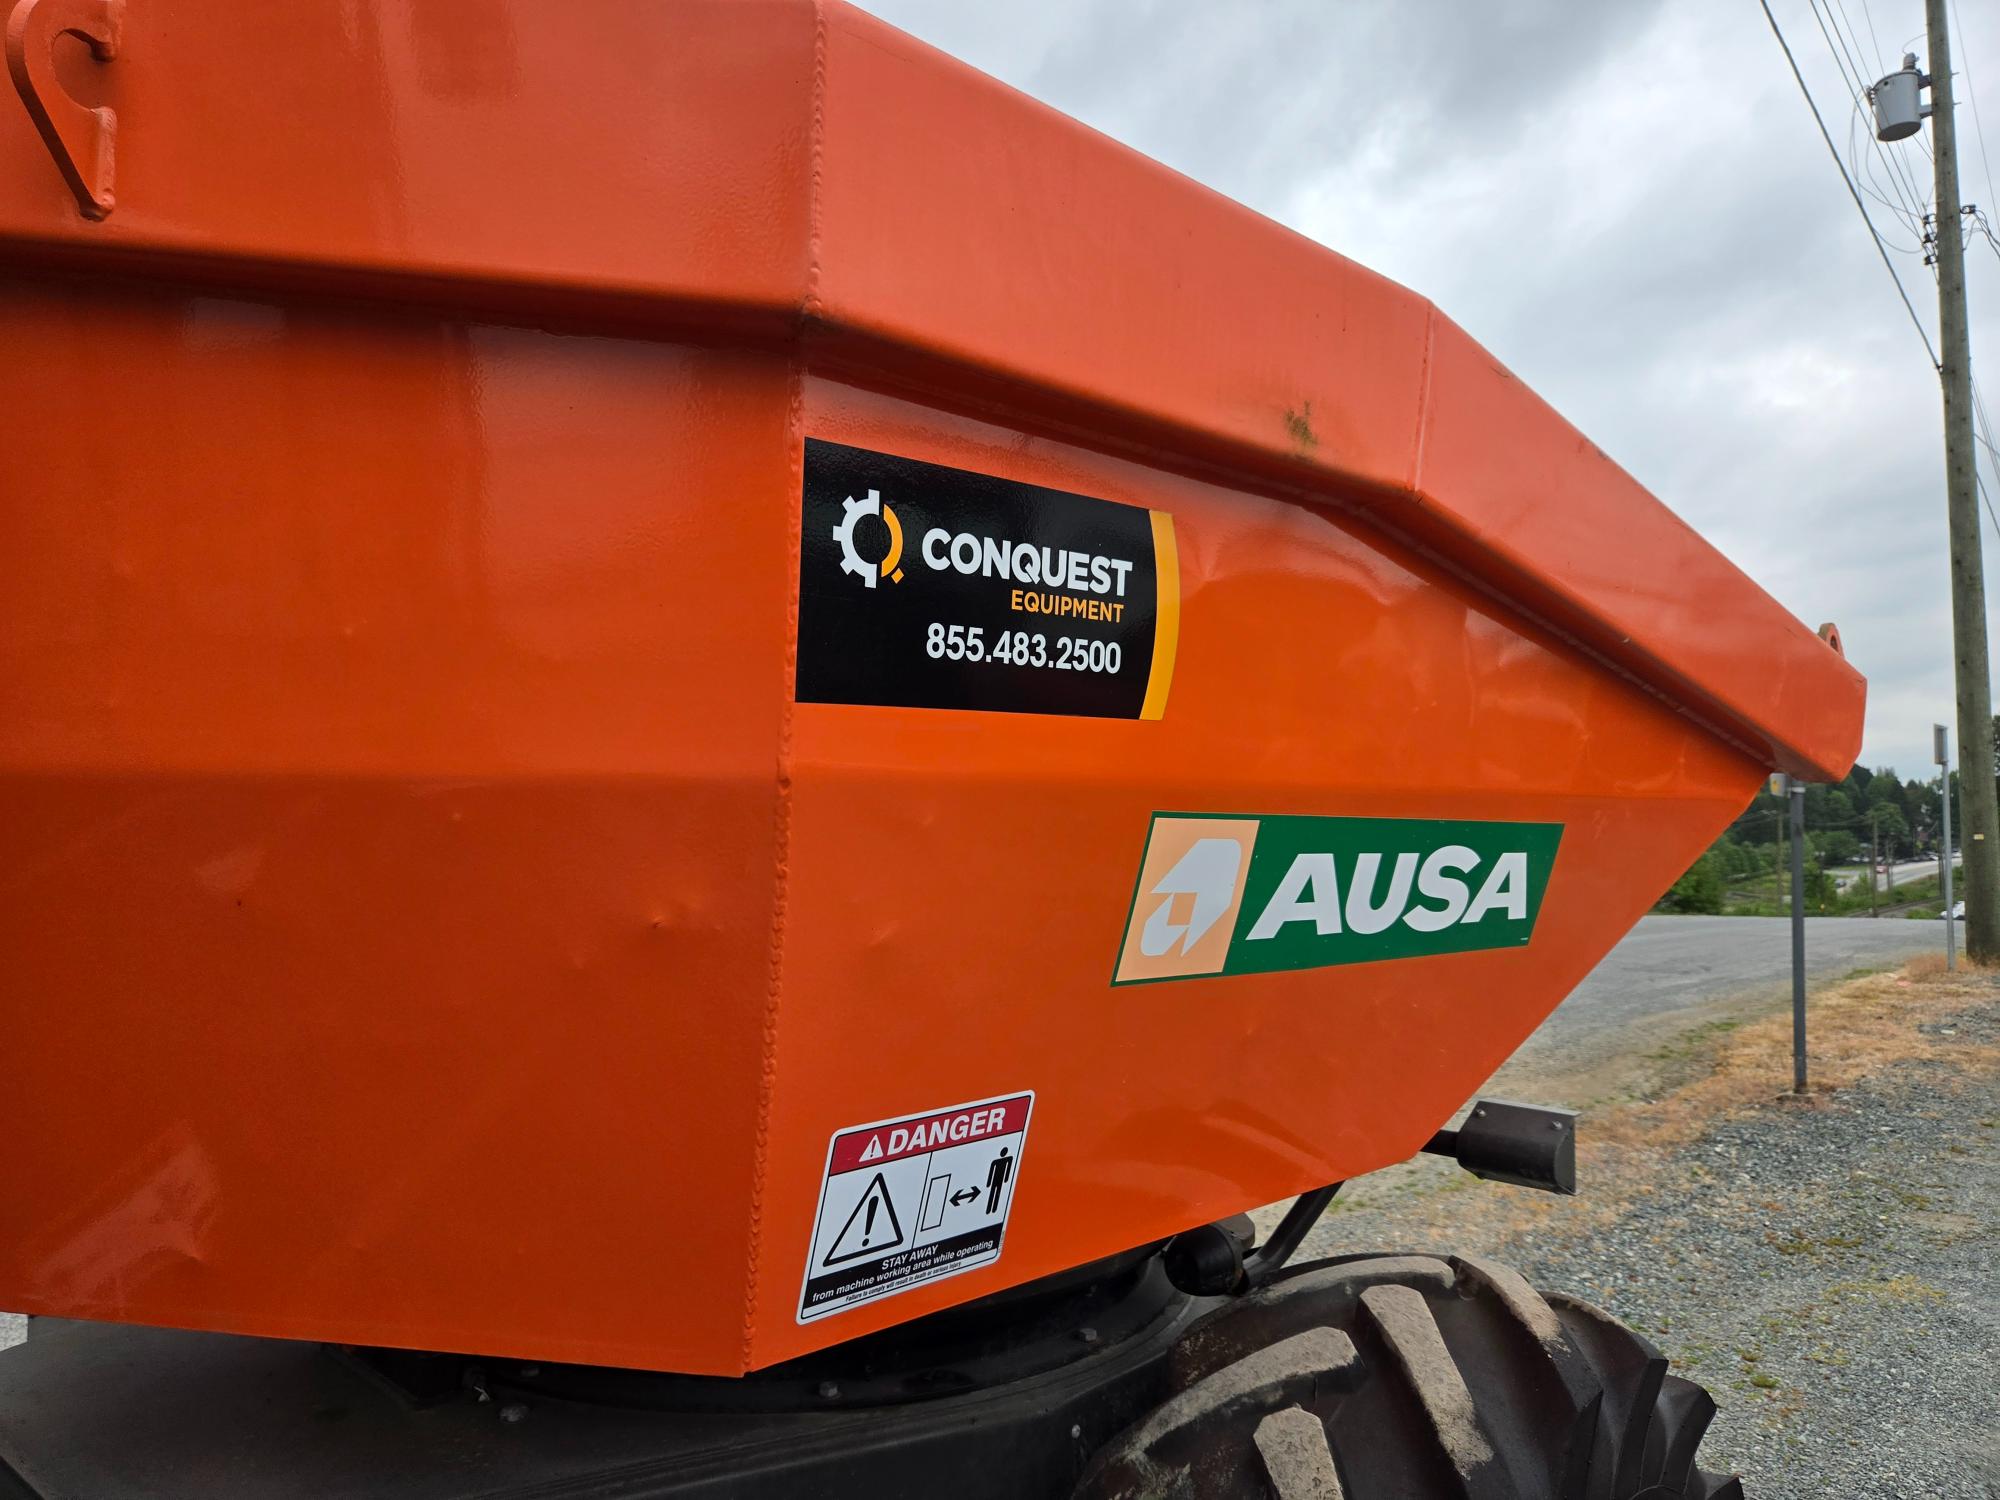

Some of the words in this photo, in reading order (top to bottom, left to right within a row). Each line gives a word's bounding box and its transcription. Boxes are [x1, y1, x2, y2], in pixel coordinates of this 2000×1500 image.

[921, 527, 1133, 597] CONQUEST
[1011, 589, 1124, 623] EQUIPMENT
[926, 622, 1122, 674] 855.483.2500
[1245, 845, 1528, 940] AUSA
[887, 1107, 1006, 1156] DANGER
[812, 1289, 834, 1302] from
[836, 1276, 875, 1295] machine
[876, 1265, 911, 1282] working
[912, 1259, 931, 1271] area
[933, 1251, 955, 1264] while
[956, 1240, 993, 1258] operating
[882, 1253, 908, 1270] STAY
[909, 1244, 939, 1262] AWAY
[845, 1292, 862, 1302] Failure
[868, 1284, 886, 1296] comply
